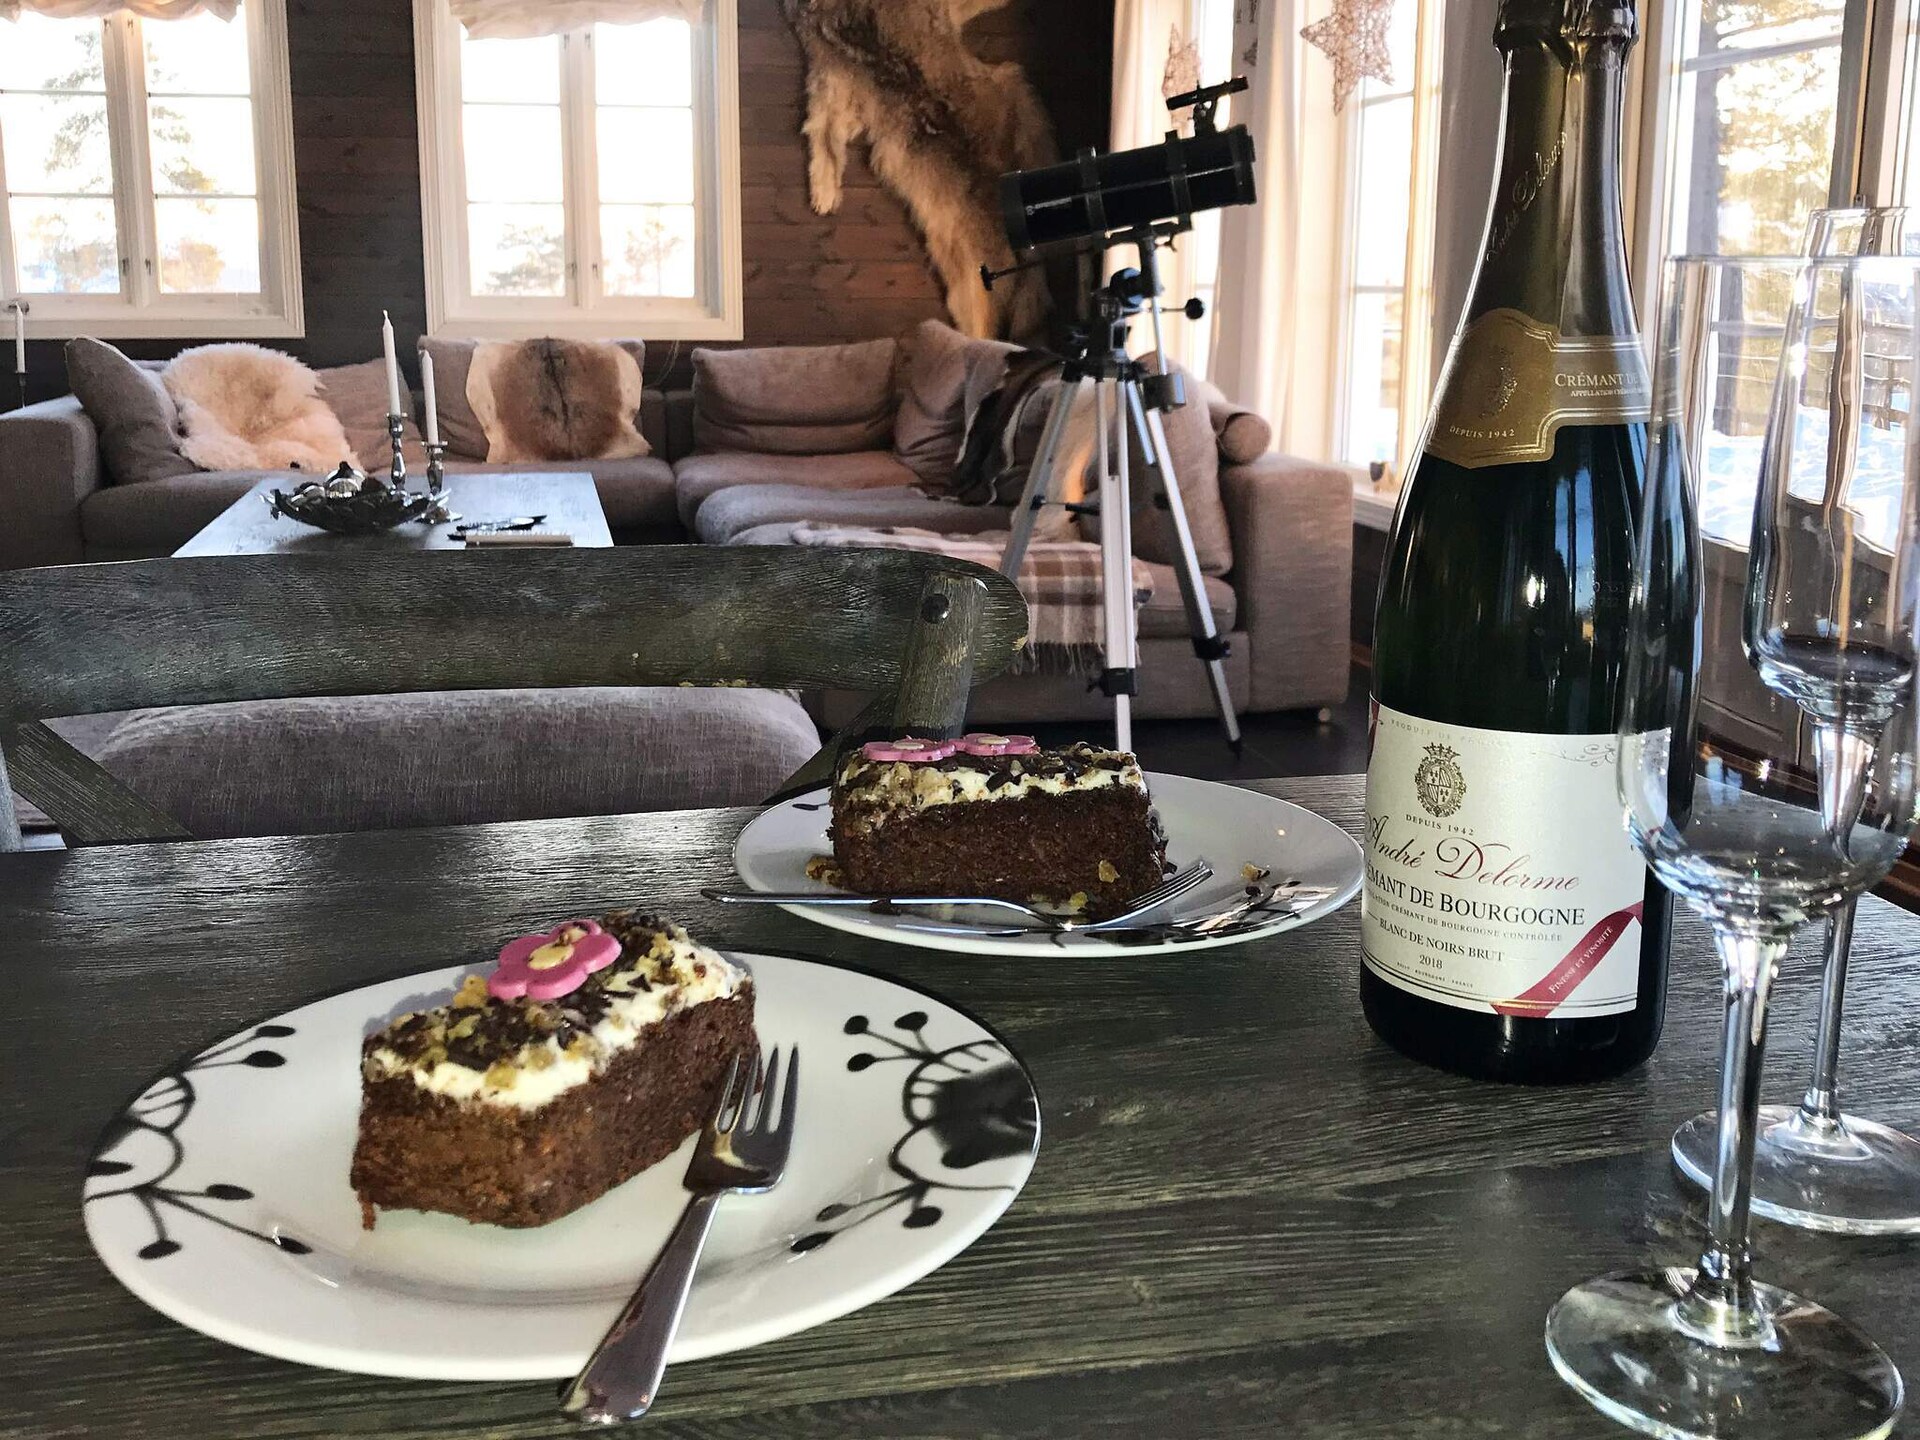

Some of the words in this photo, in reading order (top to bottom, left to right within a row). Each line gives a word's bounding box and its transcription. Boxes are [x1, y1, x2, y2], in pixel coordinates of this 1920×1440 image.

[1554, 371, 1624, 388] CRÉMANT
[1449, 425, 1484, 438] DEPUIS
[1488, 428, 1516, 439] 1942
[1405, 814, 1442, 830] DEPUIS
[1448, 824, 1475, 836] 1942
[1365, 812, 1426, 868] André
[1434, 836, 1580, 891] Delorme
[1366, 859, 1407, 899] ÉMANT
[1409, 885, 1434, 909] DE
[1440, 892, 1586, 926] BOURGOGNE
[1427, 916, 1439, 926] DE
[1441, 920, 1500, 938] BOURGOGNE
[1379, 917, 1408, 939] BLANC
[1409, 930, 1424, 946] DE
[1426, 936, 1466, 956] NOIRS
[1468, 946, 1506, 962] BRUT
[1419, 954, 1444, 970] 2018
[1574, 956, 1586, 969] ET
